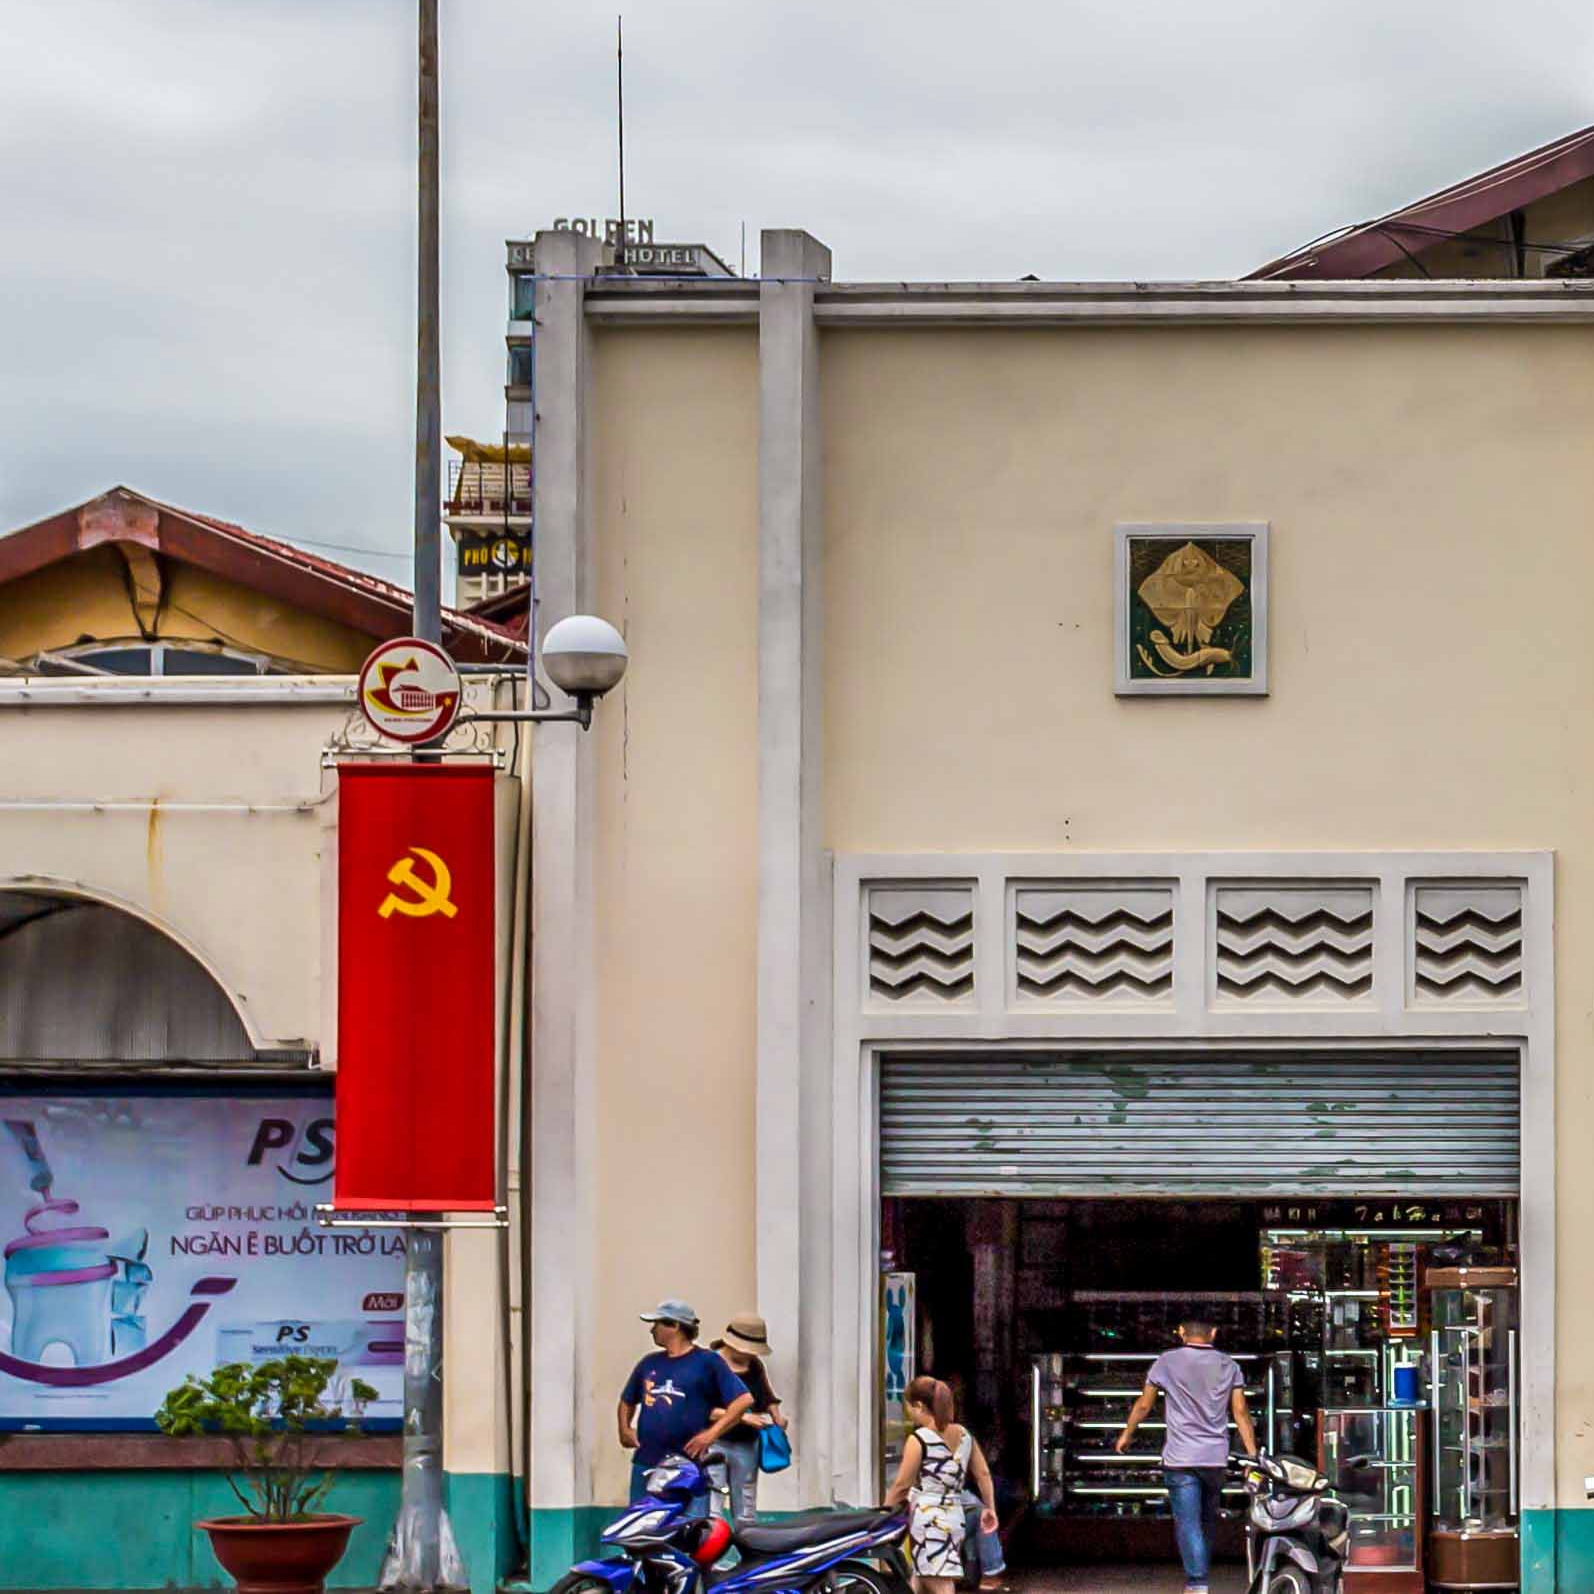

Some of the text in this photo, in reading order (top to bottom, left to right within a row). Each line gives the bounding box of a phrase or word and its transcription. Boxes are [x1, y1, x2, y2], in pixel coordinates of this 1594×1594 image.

[624, 247, 697, 264] HOTEL
[171, 1231, 241, 1256] NGĂN
[265, 1227, 328, 1256] BUỐT
[332, 1229, 376, 1256] TRỞ
[381, 1236, 407, 1260] LẠ
